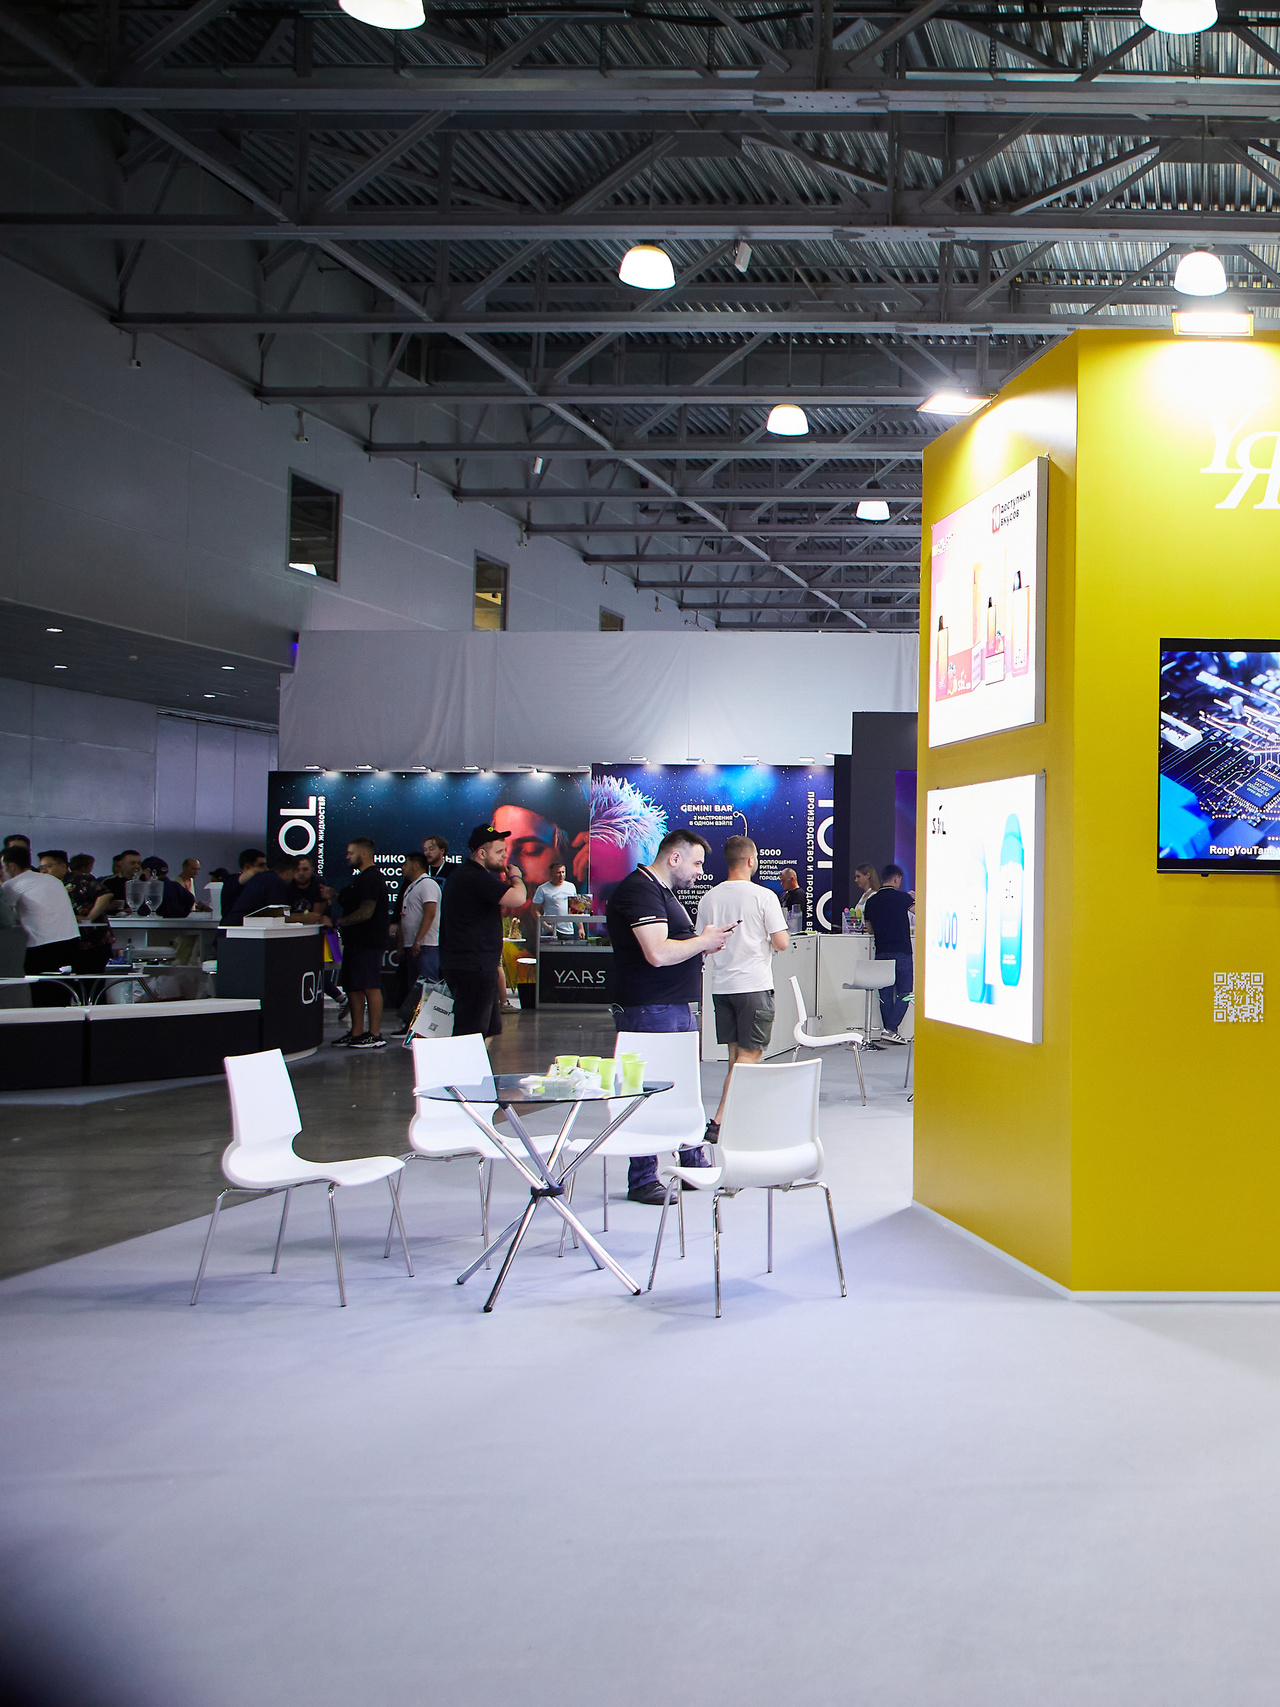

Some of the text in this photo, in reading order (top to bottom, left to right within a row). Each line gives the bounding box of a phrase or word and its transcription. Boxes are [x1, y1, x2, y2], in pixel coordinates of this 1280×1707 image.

[806, 791, 816, 863] ПРОИЗВОДСТВО
[1209, 845, 1276, 857] RongYouTang
[805, 874, 814, 918] ПРОДАЖА
[553, 969, 607, 984] YARS
